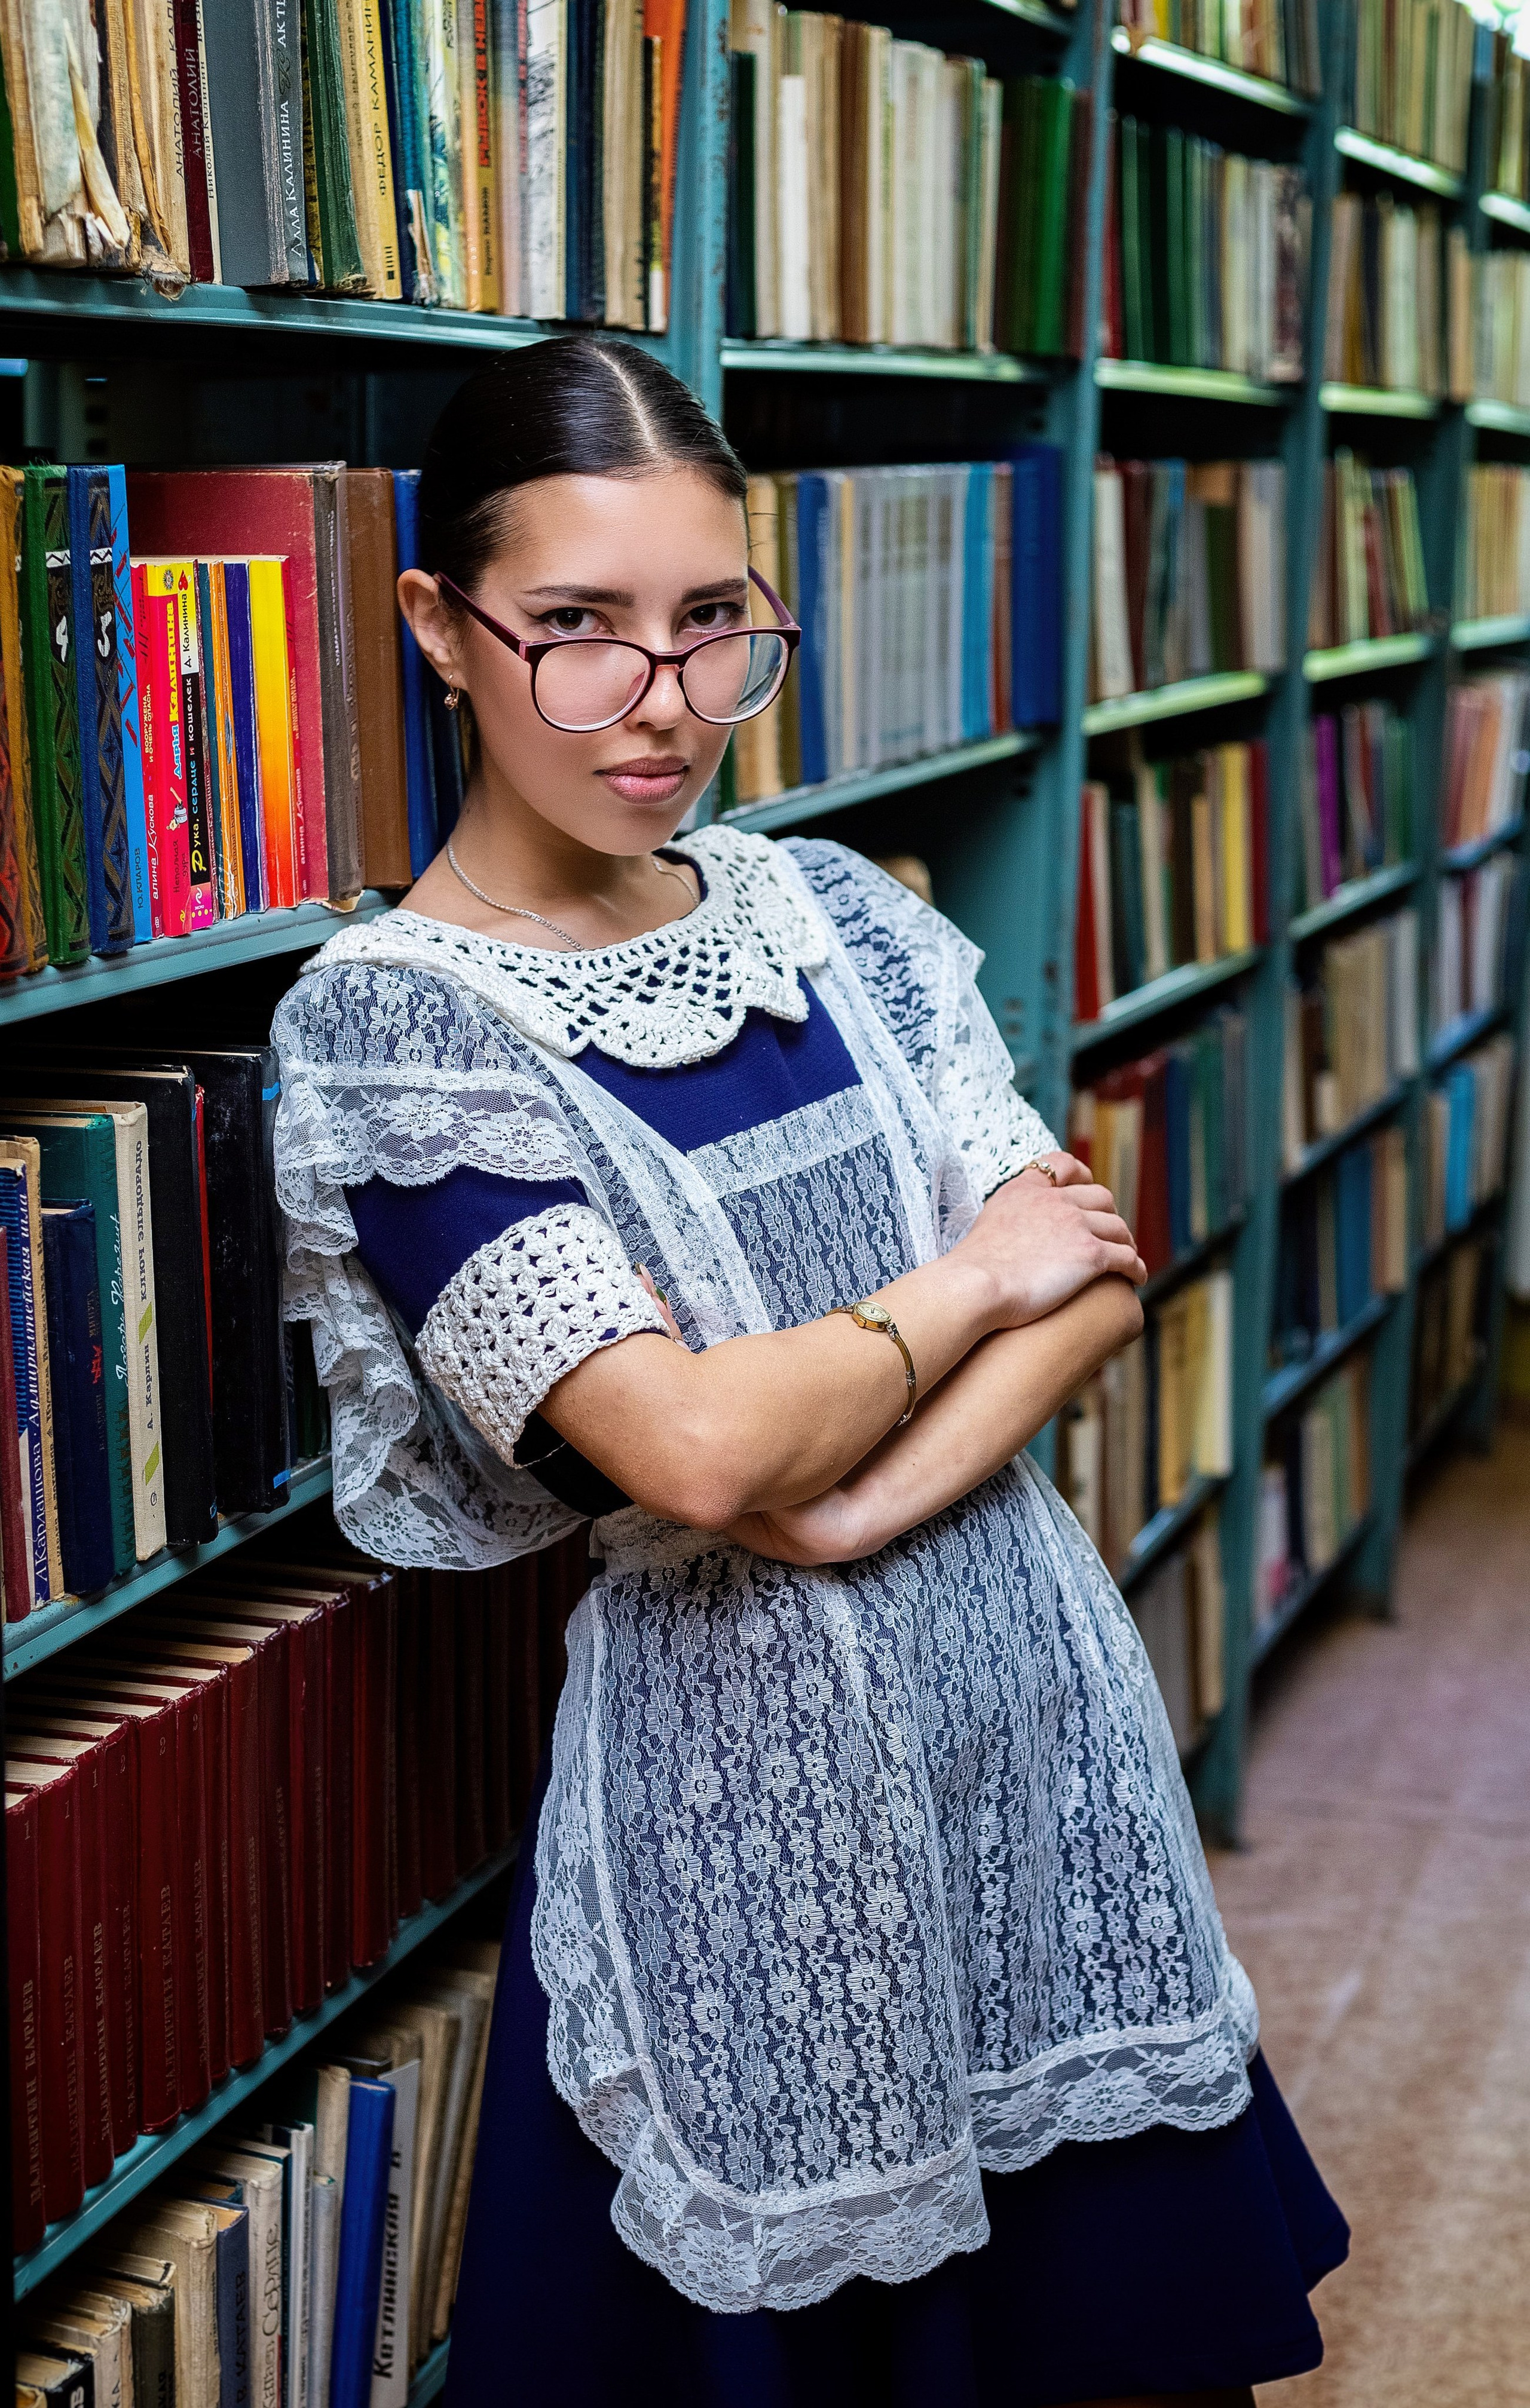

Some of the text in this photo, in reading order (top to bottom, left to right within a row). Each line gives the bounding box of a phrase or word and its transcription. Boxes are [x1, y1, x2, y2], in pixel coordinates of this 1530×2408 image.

[170, 69, 183, 179] АНАТОЛИЙ
[184, 48, 202, 158] АНАТОЛИЙ
[280, 100, 296, 201] КАЛИНИНА
[180, 594, 190, 652] Калинина
[167, 601, 182, 780] Дарья Калинина
[185, 678, 195, 742] кошелек
[189, 761, 201, 814] сердце
[135, 1140, 147, 1302] КЛЮЧ ЭЛЬДОРАДО
[21, 1247, 41, 1427] Адмиралтейская
[144, 1343, 152, 1407] Карлин
[158, 1885, 173, 1967] КАТАЕВ
[23, 1979, 42, 2205] ВАЛЕНТИН КАТАЕВ
